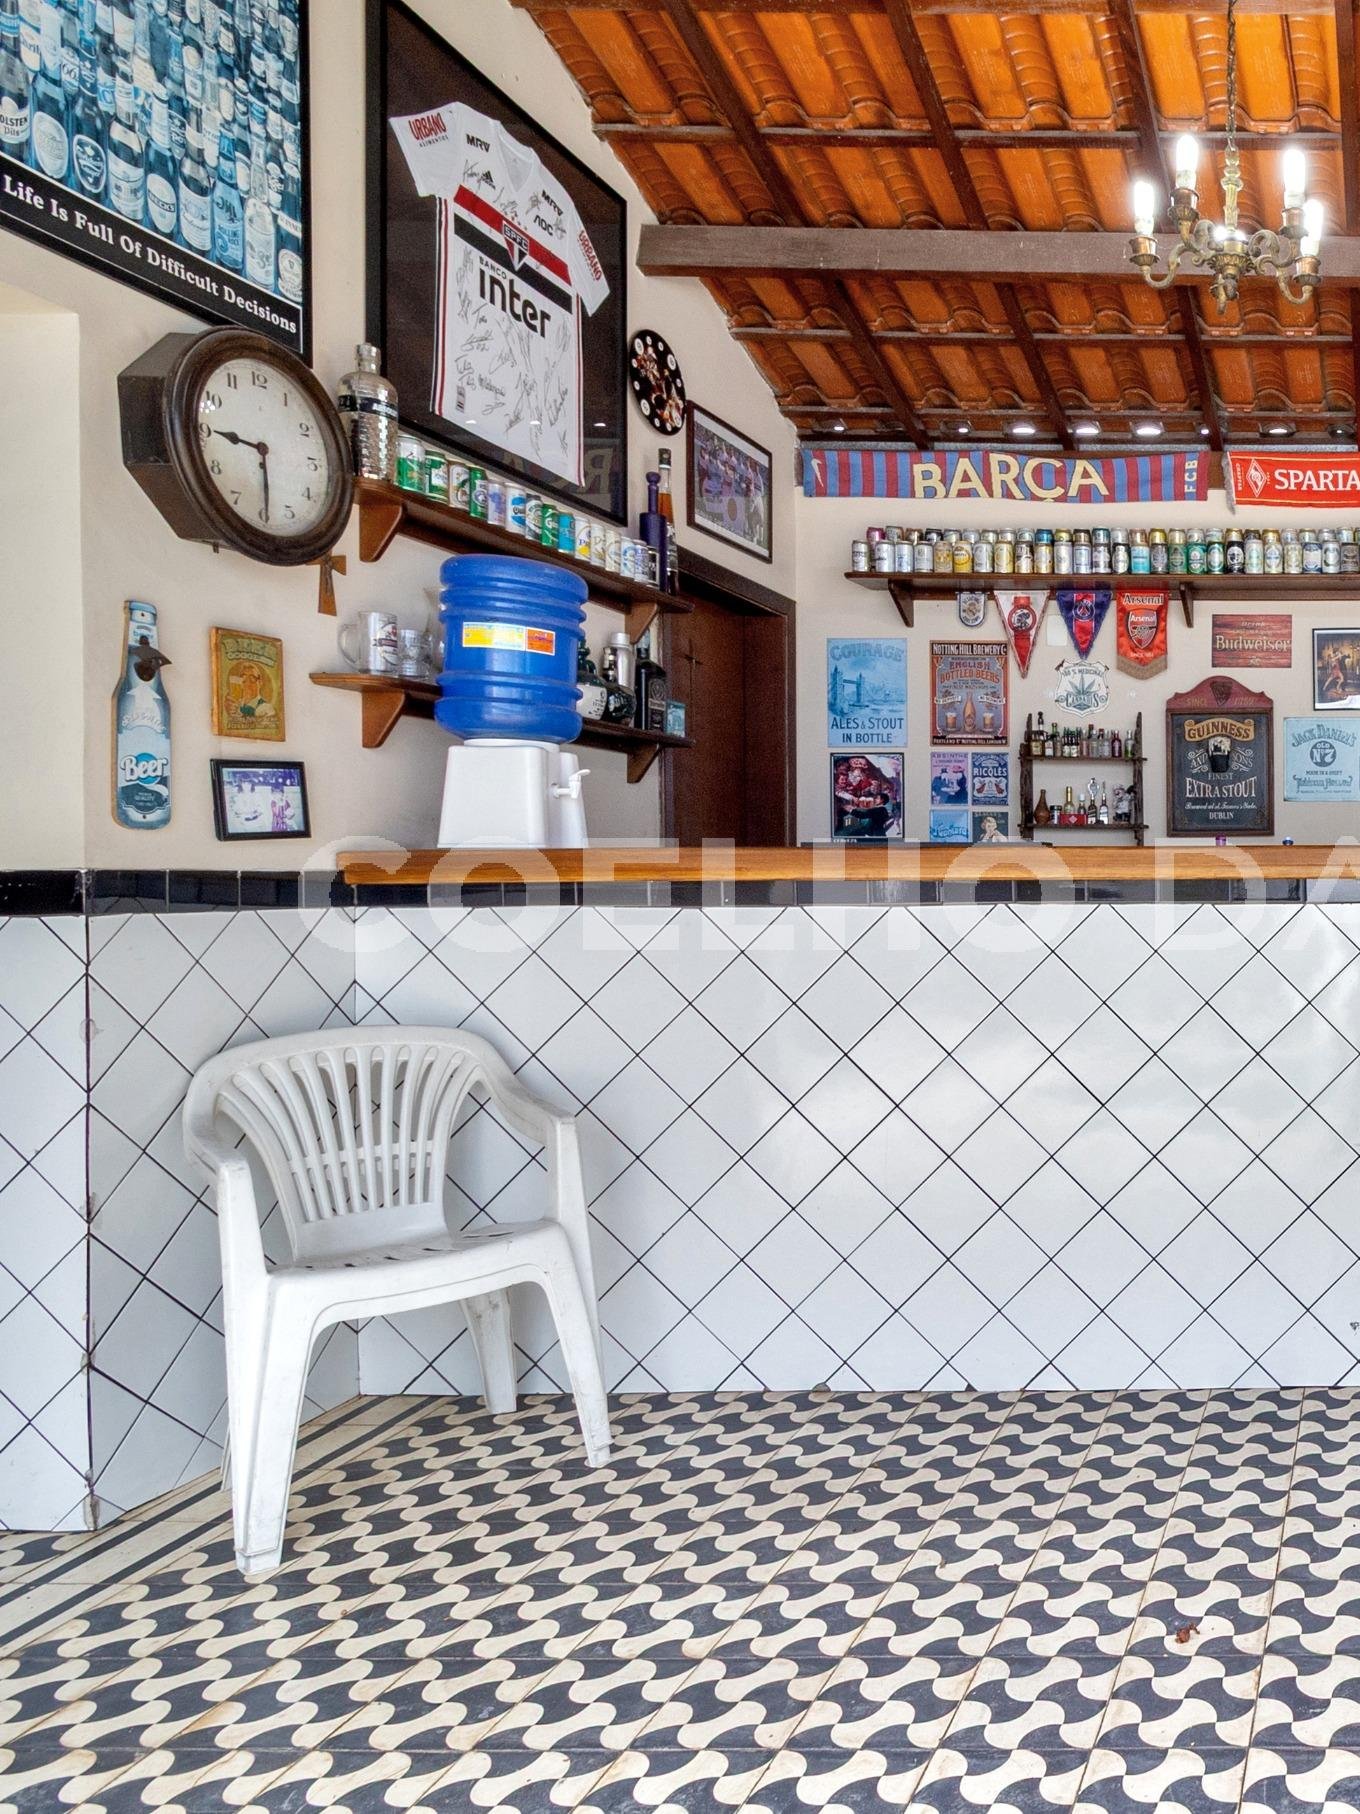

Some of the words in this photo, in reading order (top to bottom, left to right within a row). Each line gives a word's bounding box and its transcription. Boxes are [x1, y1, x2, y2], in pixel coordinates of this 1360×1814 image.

[408, 112, 447, 141] URBANO
[465, 133, 491, 153] MRV
[541, 188, 564, 216] MRV
[503, 223, 529, 252] SPFC
[3, 173, 45, 210] Life
[50, 198, 69, 222] Is
[74, 210, 115, 245] Full
[120, 234, 142, 259] Of
[146, 246, 220, 297] Difficult
[222, 285, 297, 334] Decisions
[579, 229, 603, 281] URBANO
[479, 256, 507, 280] BANCO
[479, 267, 552, 339] inter
[226, 372, 238, 390] 11
[251, 370, 268, 390] 12
[283, 392, 289, 407] 1
[210, 459, 222, 475] 8
[912, 452, 1110, 502] BARÇA
[1184, 459, 1198, 494] FCB
[229, 489, 242, 505] 7
[300, 486, 311, 501] 4
[1123, 593, 1164, 605] Arsenal
[829, 642, 905, 662] COURAGE
[933, 643, 959, 655] NOTTING
[959, 643, 973, 655] HILL
[973, 643, 1000, 655] BREWERY
[1215, 634, 1291, 652] Budweiser
[949, 661, 991, 670] ENGLISH
[940, 669, 974, 684] BOTTLED
[975, 669, 1000, 684] BEERS
[831, 717, 860, 730] ALES
[860, 720, 866, 730] &
[868, 717, 904, 730] STOUT
[1187, 720, 1252, 740] GUINNESS
[842, 733, 853, 744] IN
[855, 733, 893, 744] BOTTLE
[1292, 728, 1318, 748] JACK
[119, 754, 169, 782] Beer
[1190, 752, 1209, 770] AND
[1208, 772, 1234, 781] FINEST
[1185, 777, 1222, 798] EXTRA
[1222, 776, 1258, 798] STOUT
[1208, 811, 1235, 820] DUBLIN
